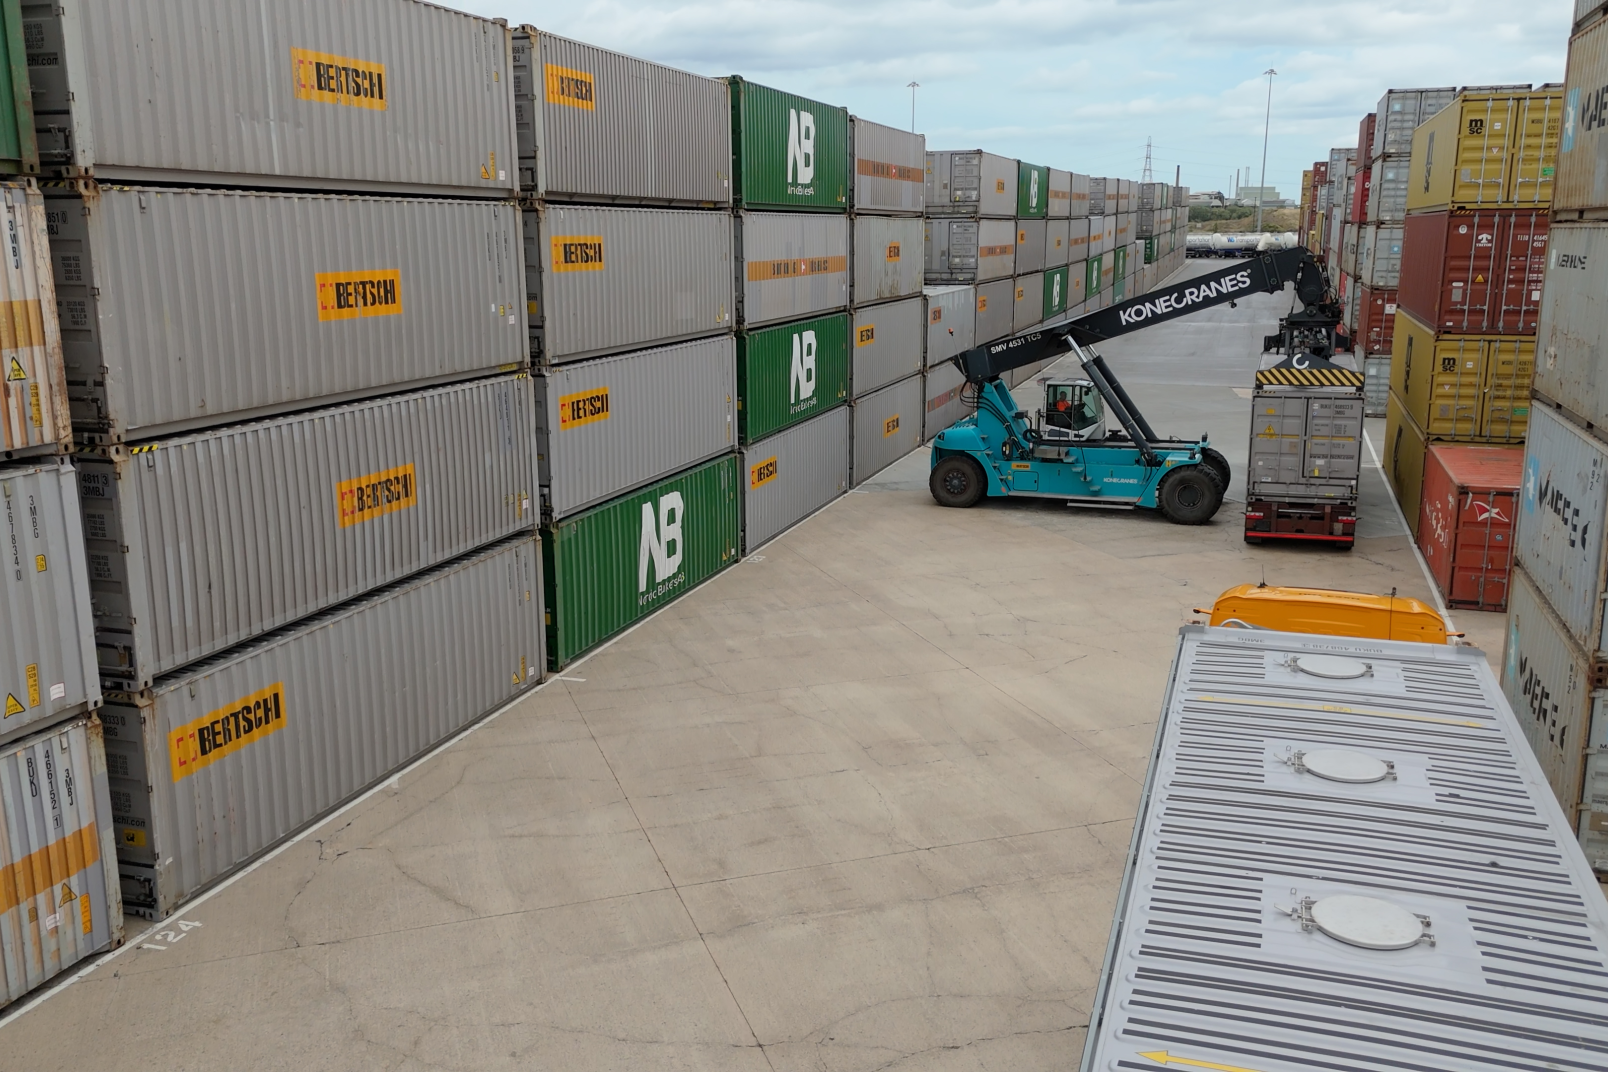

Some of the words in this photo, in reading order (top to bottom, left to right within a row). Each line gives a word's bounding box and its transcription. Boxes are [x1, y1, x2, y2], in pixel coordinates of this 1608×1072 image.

[1118, 271, 1251, 326] KONECRANES
[990, 342, 1007, 354] SMV
[1008, 338, 1025, 348] 4531
[1026, 333, 1042, 342] TC5
[83, 486, 105, 497] 3MBJ
[29, 496, 39, 538] 3MBG
[638, 490, 684, 592] NB
[198, 692, 281, 756] BERTSCHI
[45, 750, 57, 809] 466152
[64, 769, 73, 806] 3MBJ
